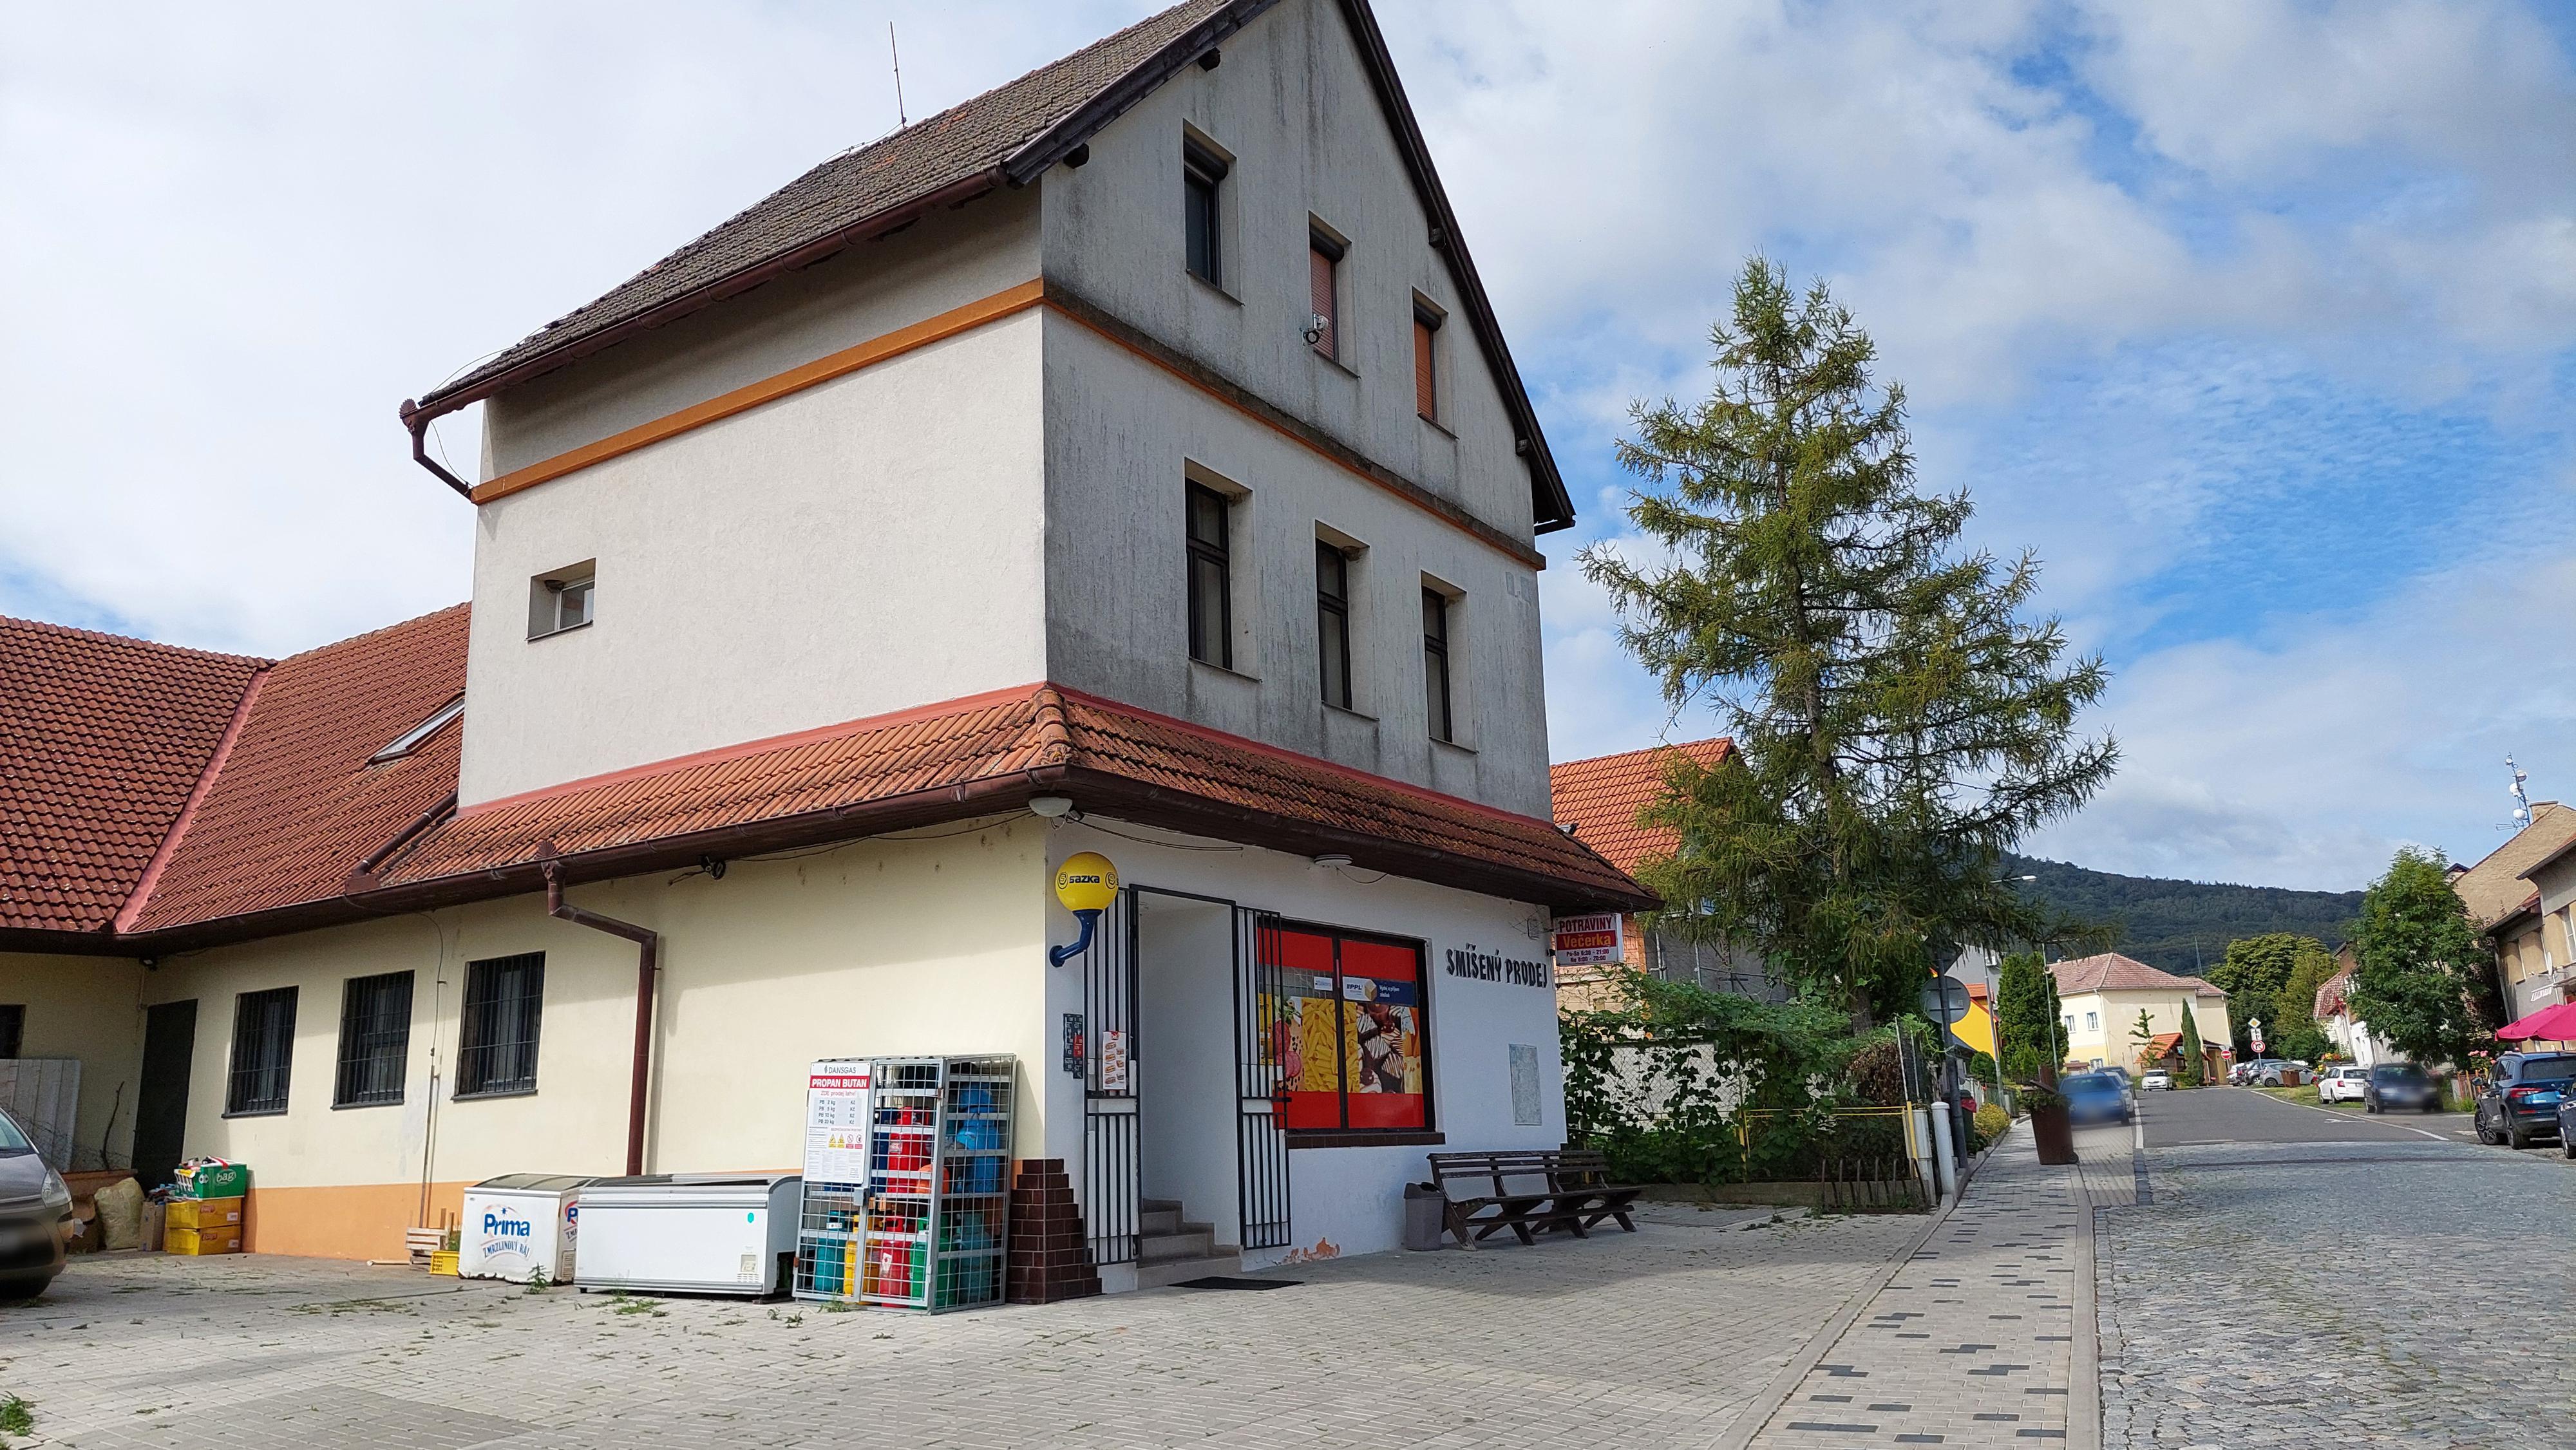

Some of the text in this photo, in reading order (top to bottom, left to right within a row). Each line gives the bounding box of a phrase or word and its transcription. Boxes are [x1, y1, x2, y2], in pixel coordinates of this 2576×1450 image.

[1069, 875, 1100, 883] sazka
[1558, 917, 1612, 932] POTRAVINY
[1562, 933, 1611, 948] Večerka
[1446, 943, 1548, 988] SMÍŠENÝ PRODEJ
[811, 1078, 867, 1088] PROPAN BUTAN
[484, 1213, 531, 1237] Prima
